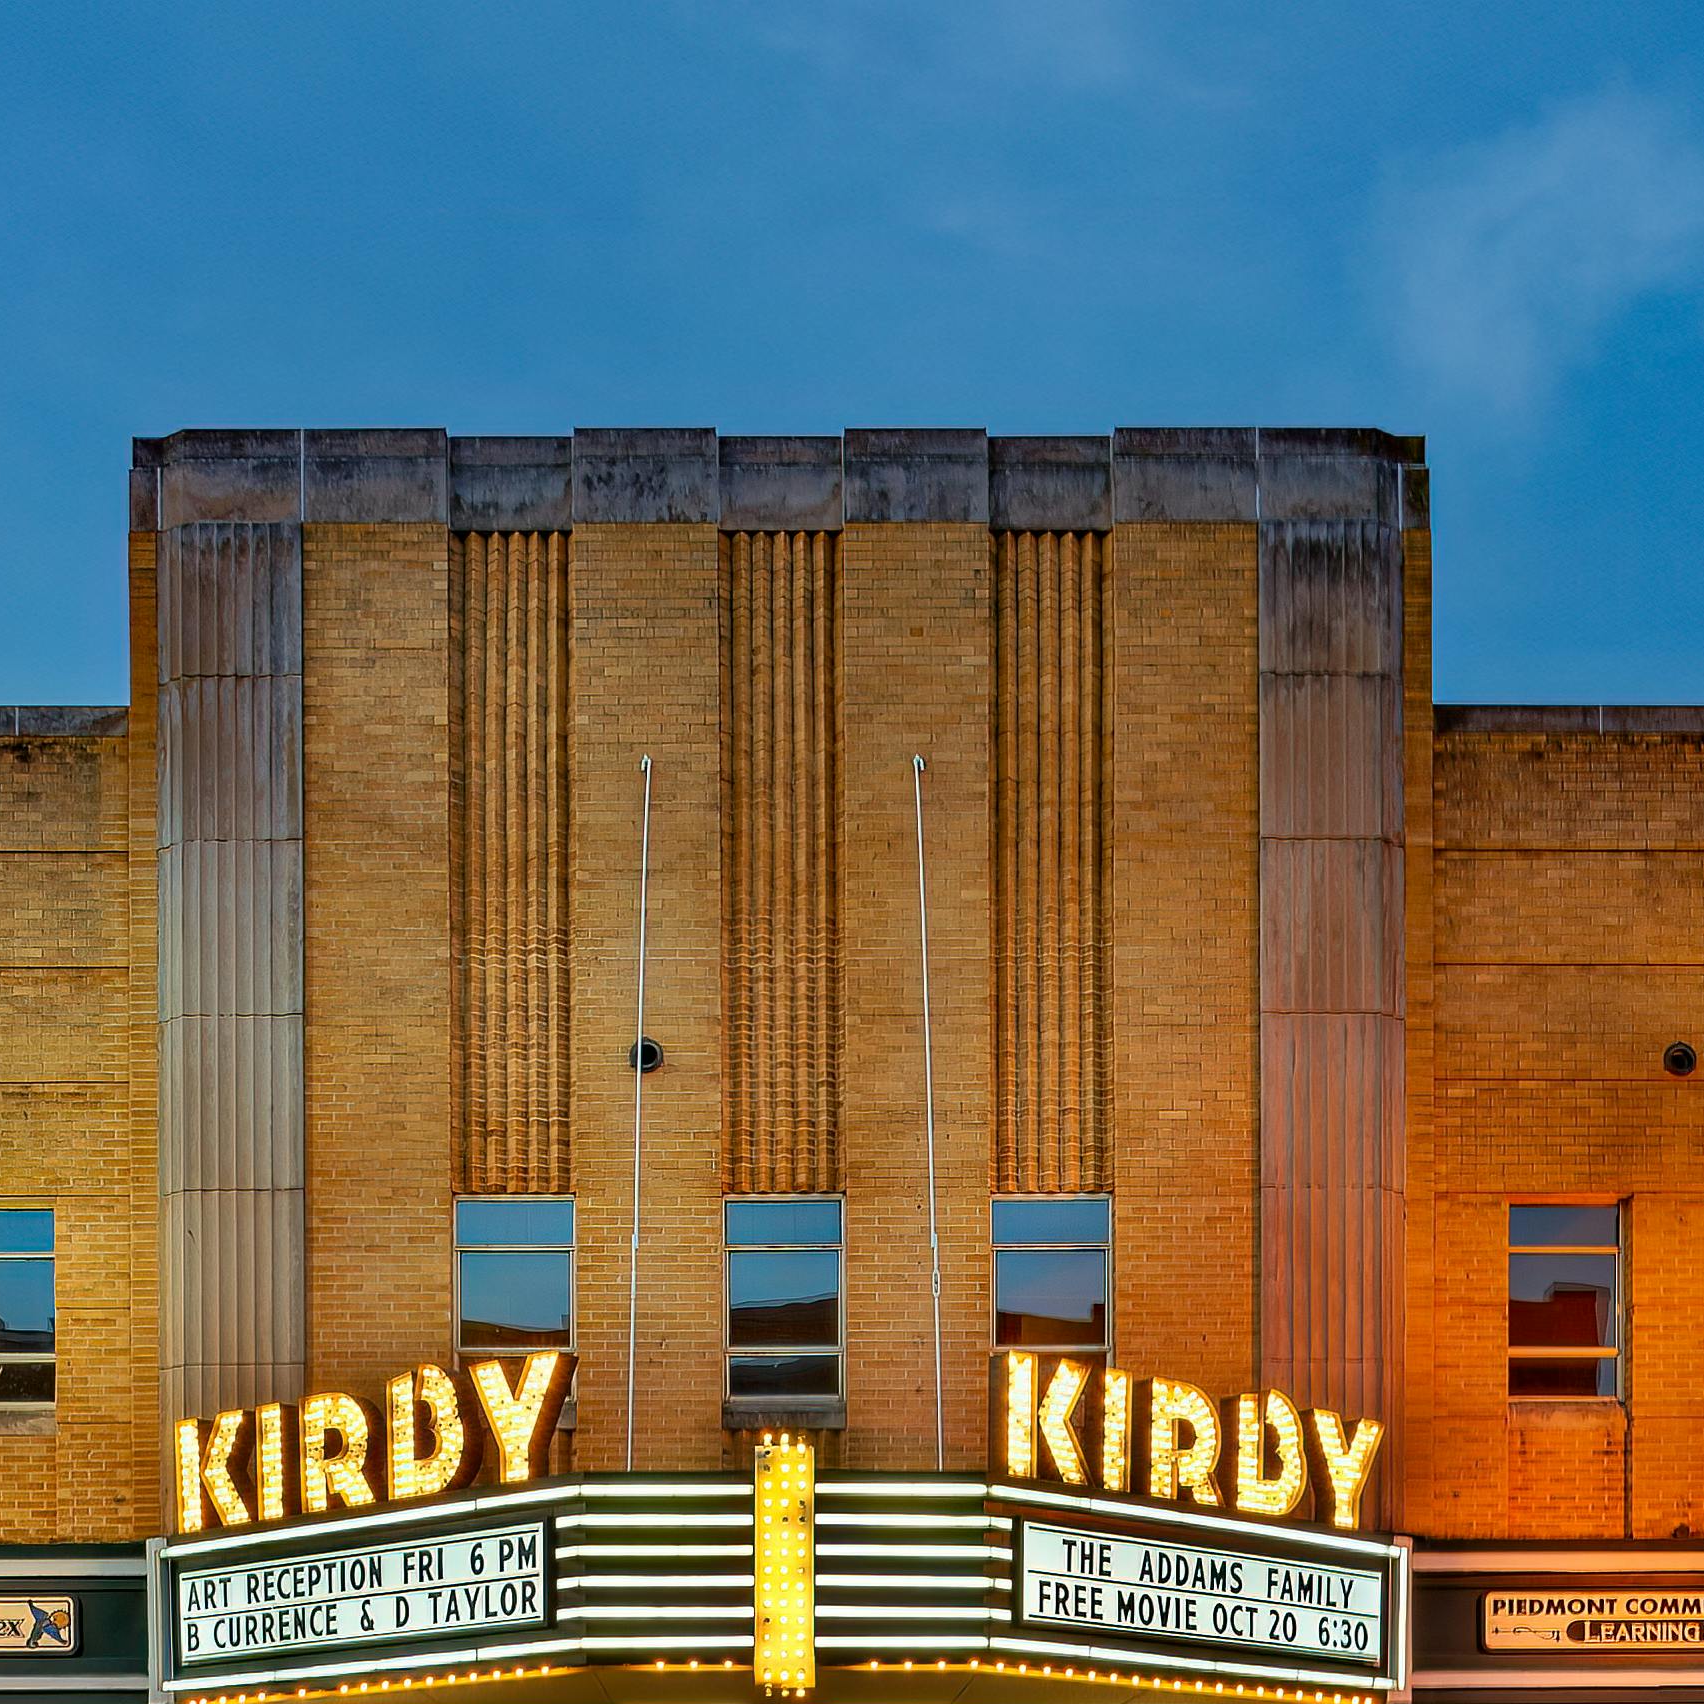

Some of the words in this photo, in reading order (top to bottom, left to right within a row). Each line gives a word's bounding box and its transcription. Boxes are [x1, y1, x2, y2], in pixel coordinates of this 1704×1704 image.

[175, 1351, 569, 1535] KIRBY
[1007, 1350, 1385, 1531] KIRBY
[187, 1577, 232, 1612] ART
[247, 1555, 383, 1605] RECEPTION
[403, 1547, 445, 1585] FRI
[470, 1542, 484, 1576] 6
[499, 1535, 537, 1573] PM
[1063, 1539, 1113, 1578] THE
[1139, 1550, 1243, 1595] ADDAMS
[1267, 1568, 1355, 1610] FAMILY
[1493, 1597, 1618, 1616] PIEDMONT
[187, 1623, 200, 1652] B
[213, 1604, 338, 1649] CURRENCE
[360, 1599, 375, 1632] &
[395, 1595, 410, 1629] D
[428, 1581, 538, 1624] TAYLOR
[1038, 1580, 1104, 1621] FREE
[1117, 1590, 1198, 1632] MOVIE
[1212, 1602, 1259, 1638] OCT
[1268, 1609, 1297, 1643] 20
[1318, 1616, 1369, 1652] 6:30
[1583, 1620, 1700, 1644] LEARNING
